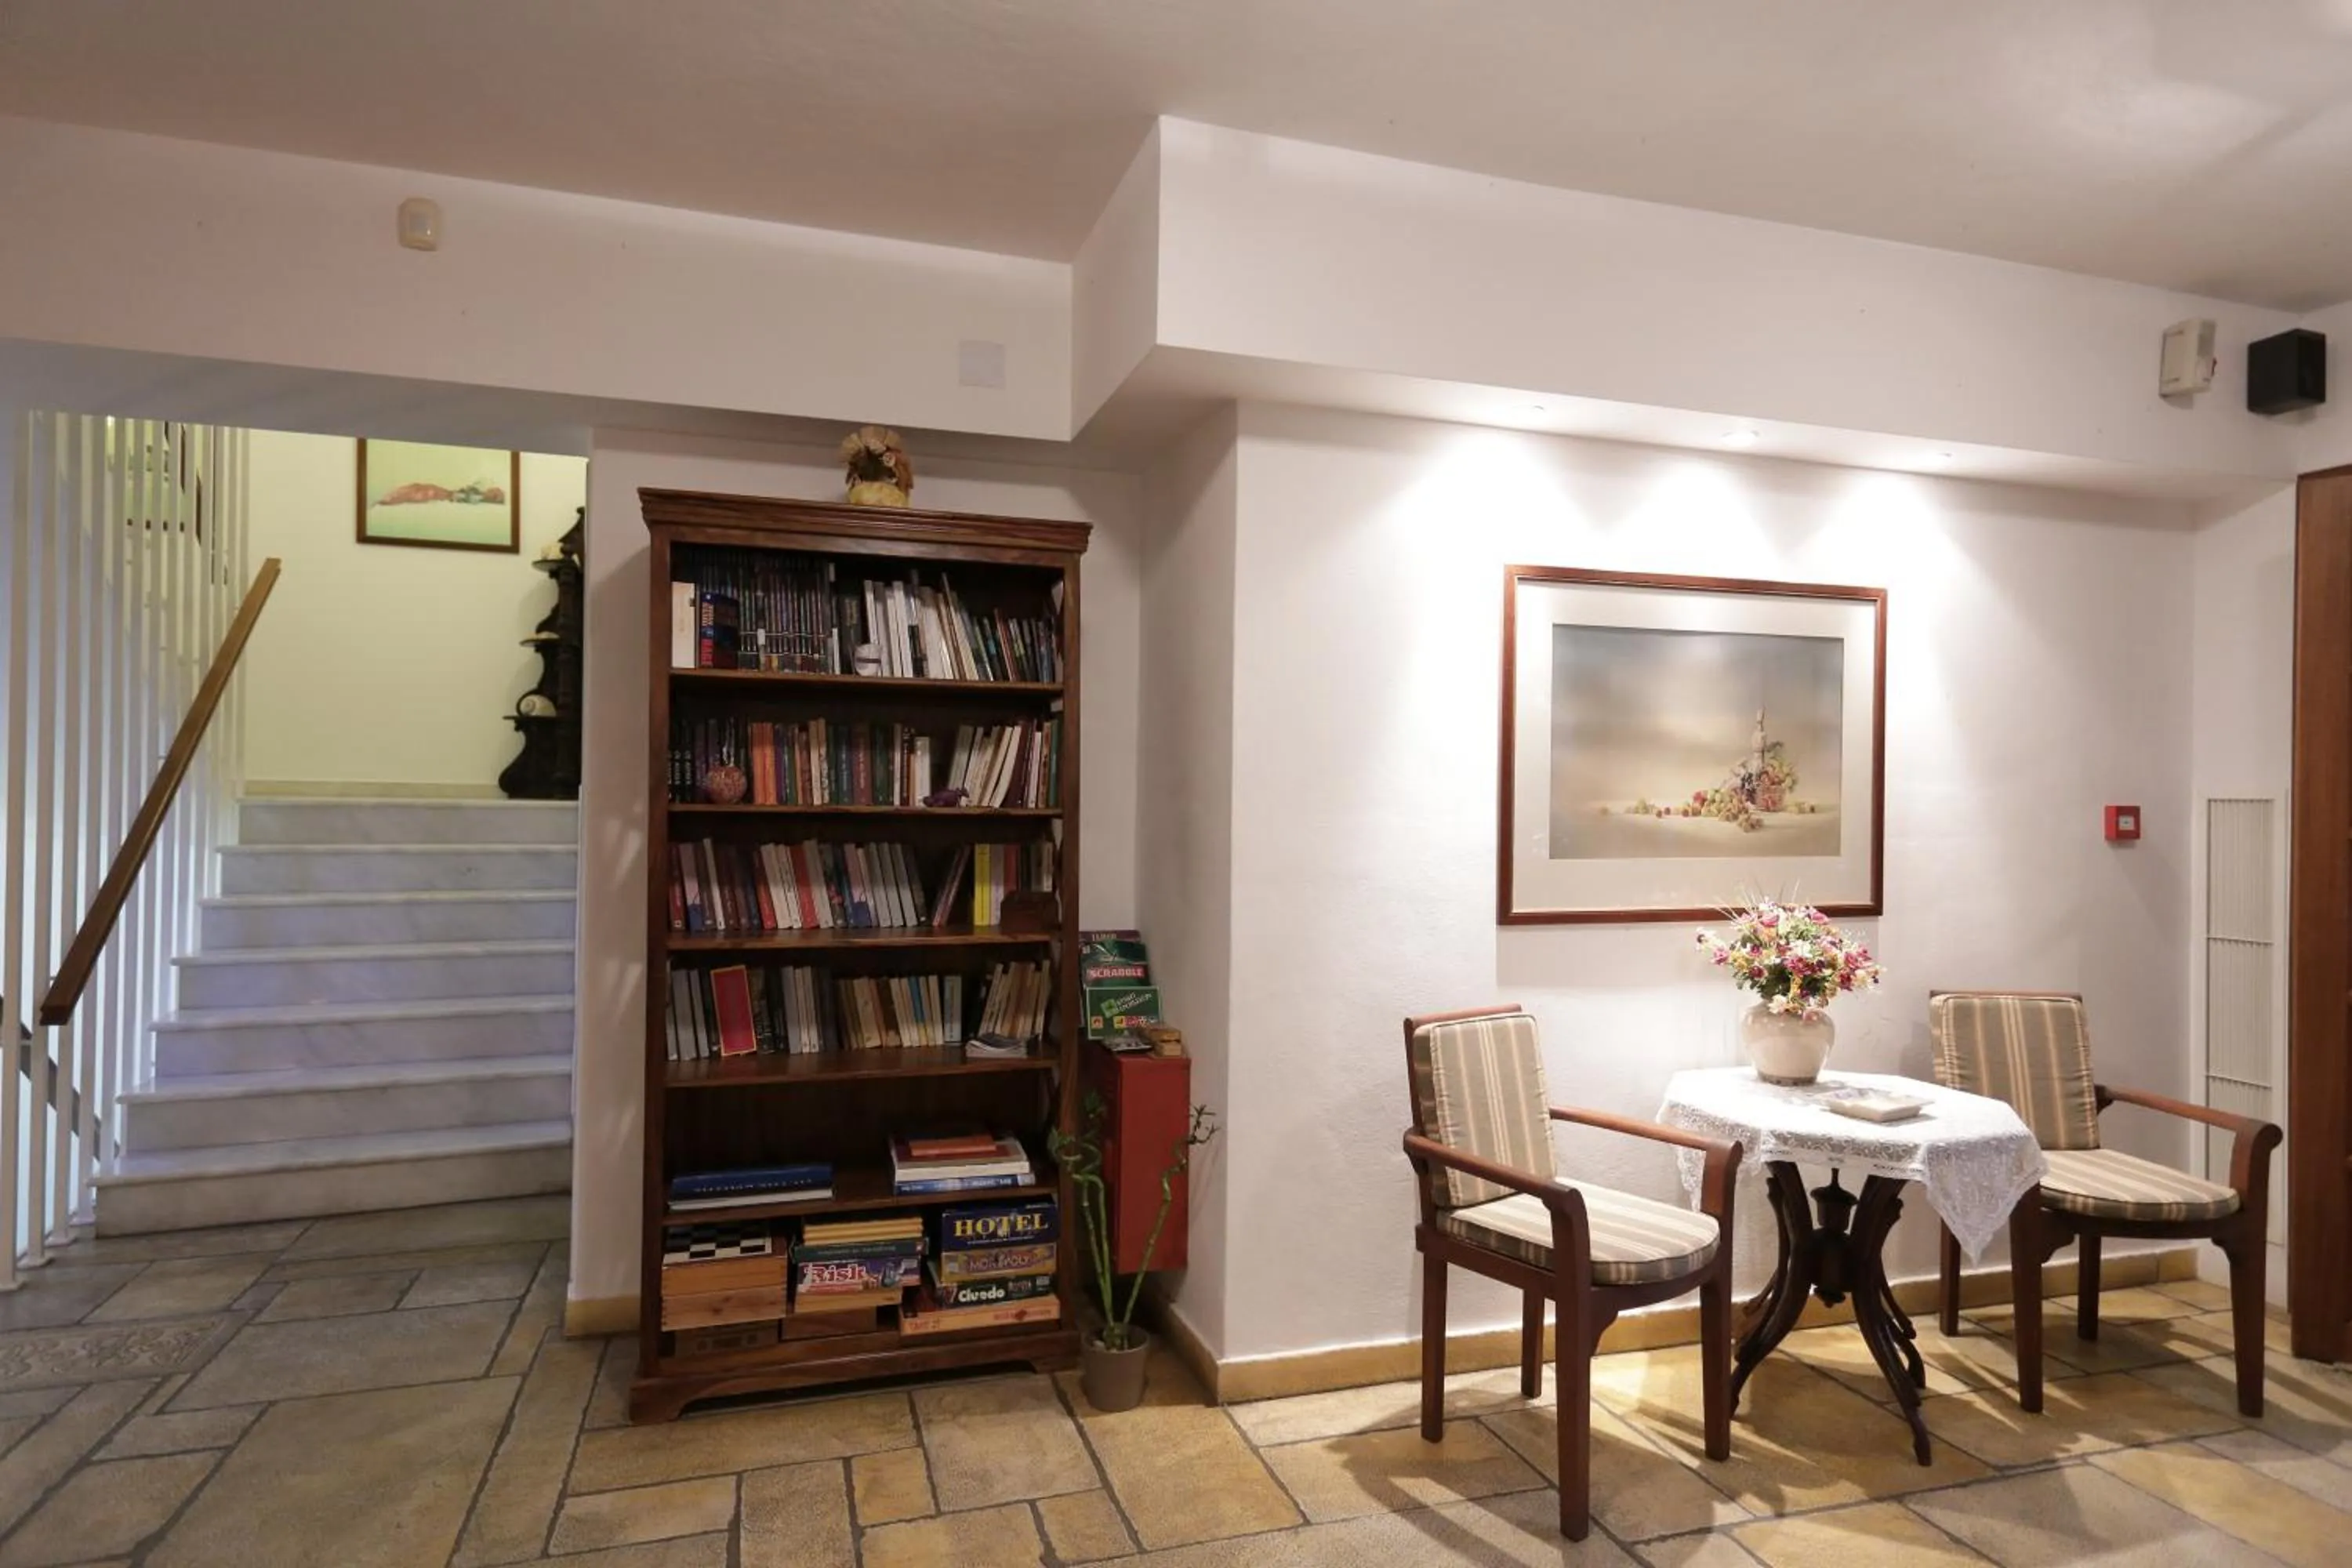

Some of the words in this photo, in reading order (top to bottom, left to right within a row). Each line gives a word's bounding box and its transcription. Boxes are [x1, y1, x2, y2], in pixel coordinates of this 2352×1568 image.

[1090, 967, 1144, 978] SCRABBLE
[954, 1214, 1049, 1236] HOTEL
[803, 1263, 867, 1283] Risk
[959, 1287, 1005, 1302] Cluedo
